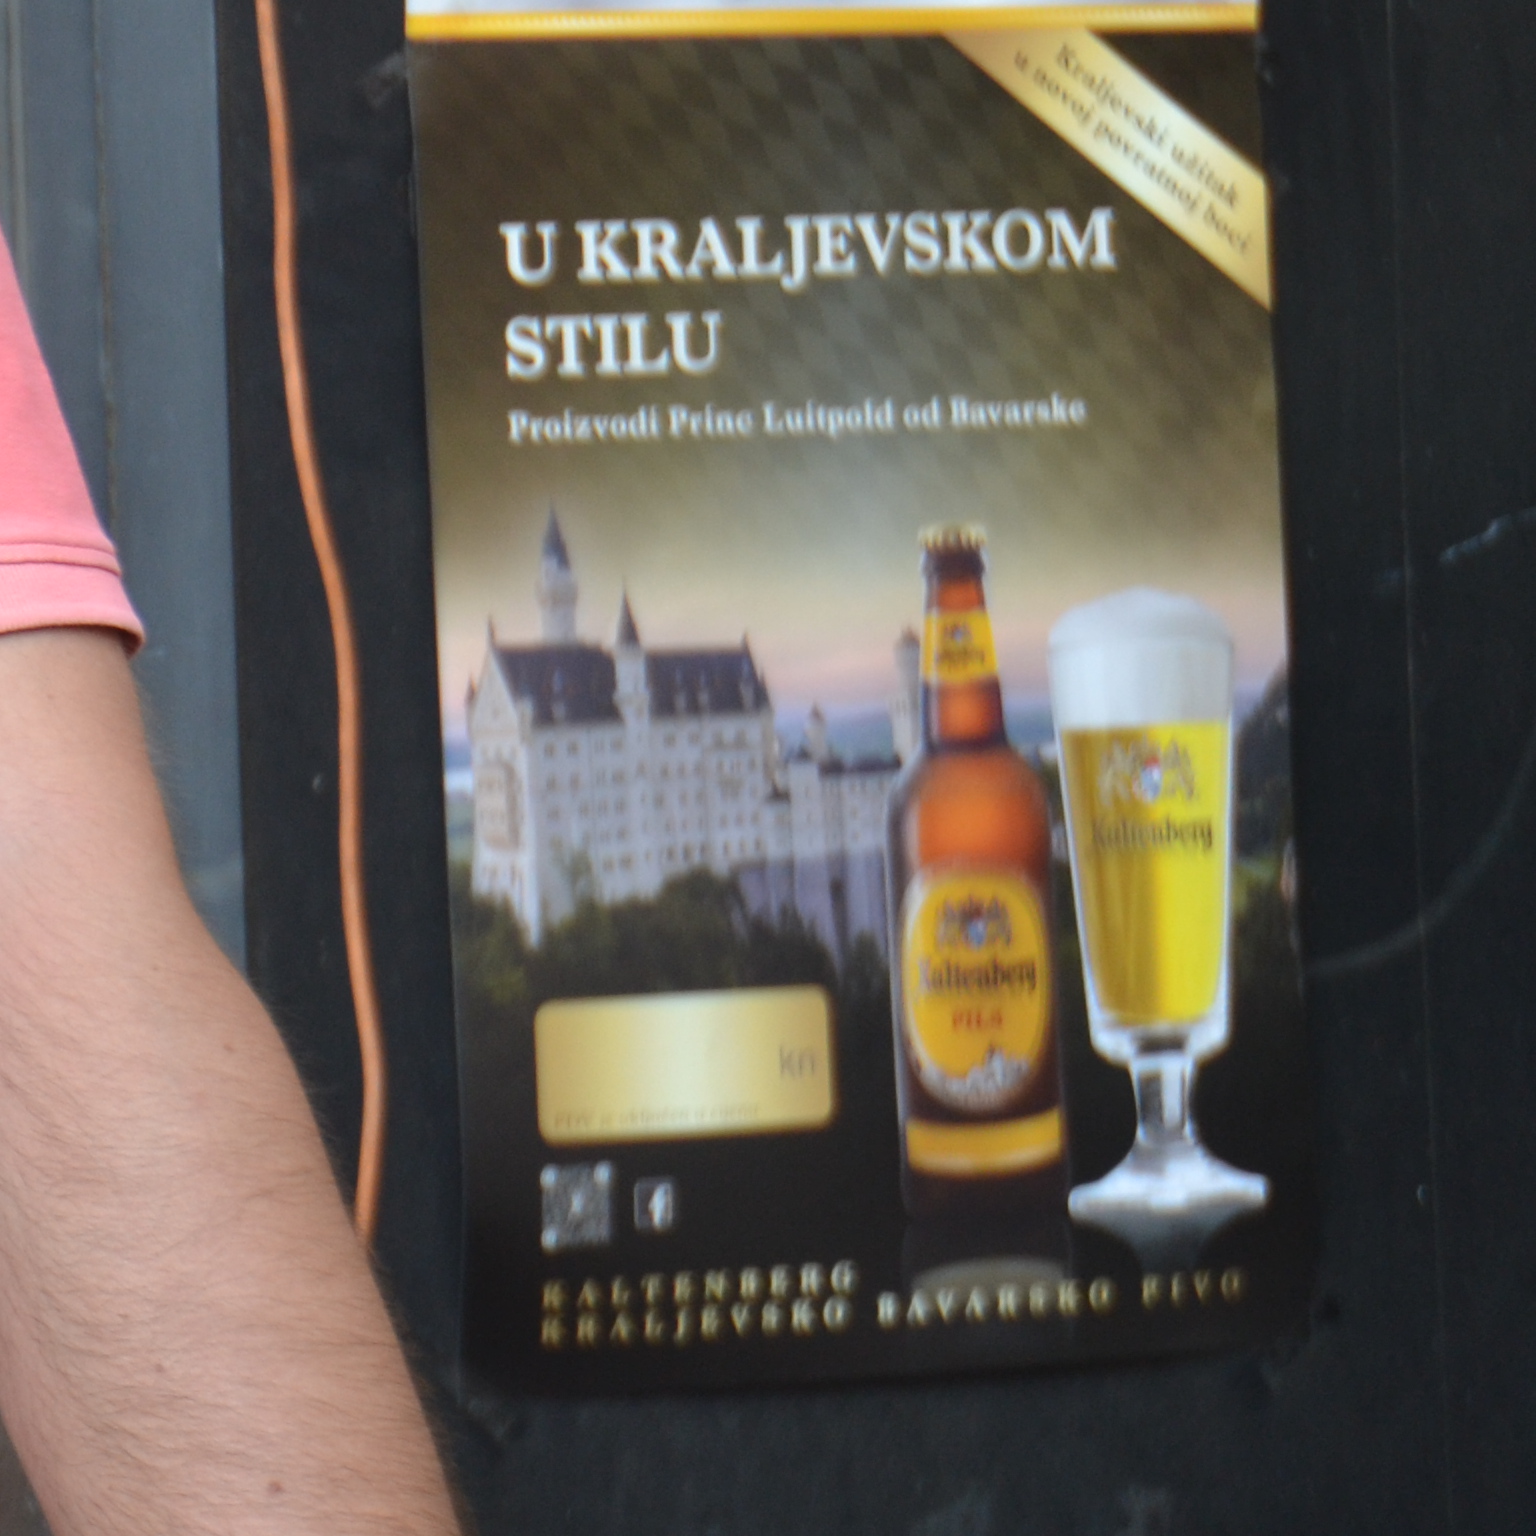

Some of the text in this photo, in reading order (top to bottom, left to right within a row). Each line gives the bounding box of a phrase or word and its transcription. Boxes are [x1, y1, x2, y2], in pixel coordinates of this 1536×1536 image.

[499, 206, 1118, 293] U KRALJEVSKOM
[504, 310, 723, 381] STILU
[507, 404, 661, 445] Proizvodi
[761, 396, 895, 441] Luitpold
[901, 395, 942, 431] od
